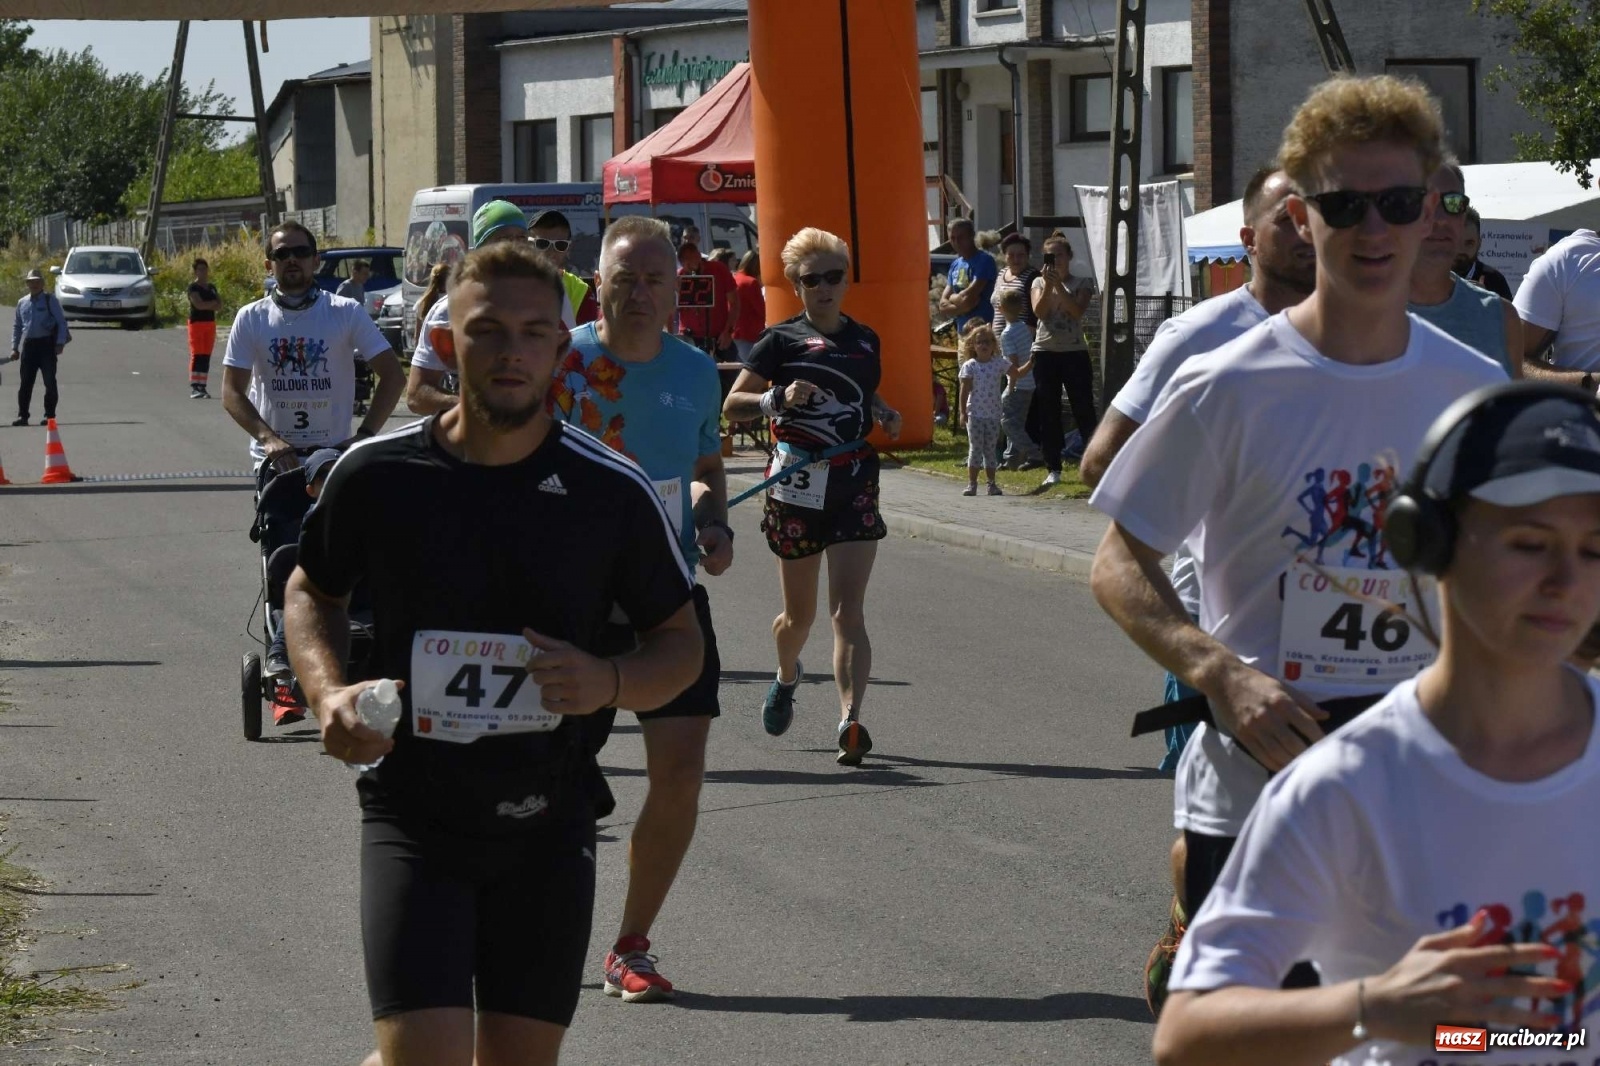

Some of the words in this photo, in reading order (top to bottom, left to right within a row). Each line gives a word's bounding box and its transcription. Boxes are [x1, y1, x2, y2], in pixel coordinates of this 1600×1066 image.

[1487, 231, 1533, 240] Krzanowice
[1486, 249, 1528, 258] Chuchelná
[271, 379, 309, 391] COLOUR
[311, 377, 332, 391] RUN
[275, 401, 308, 410] COLOUR
[293, 410, 310, 430] 3
[538, 484, 567, 495] adidas
[660, 484, 678, 496] RUN
[1299, 573, 1391, 600] COLOUR
[1320, 602, 1410, 652] 46
[423, 638, 506, 661] COLOUR
[445, 663, 531, 709] 47
[417, 707, 443, 717] 10km,
